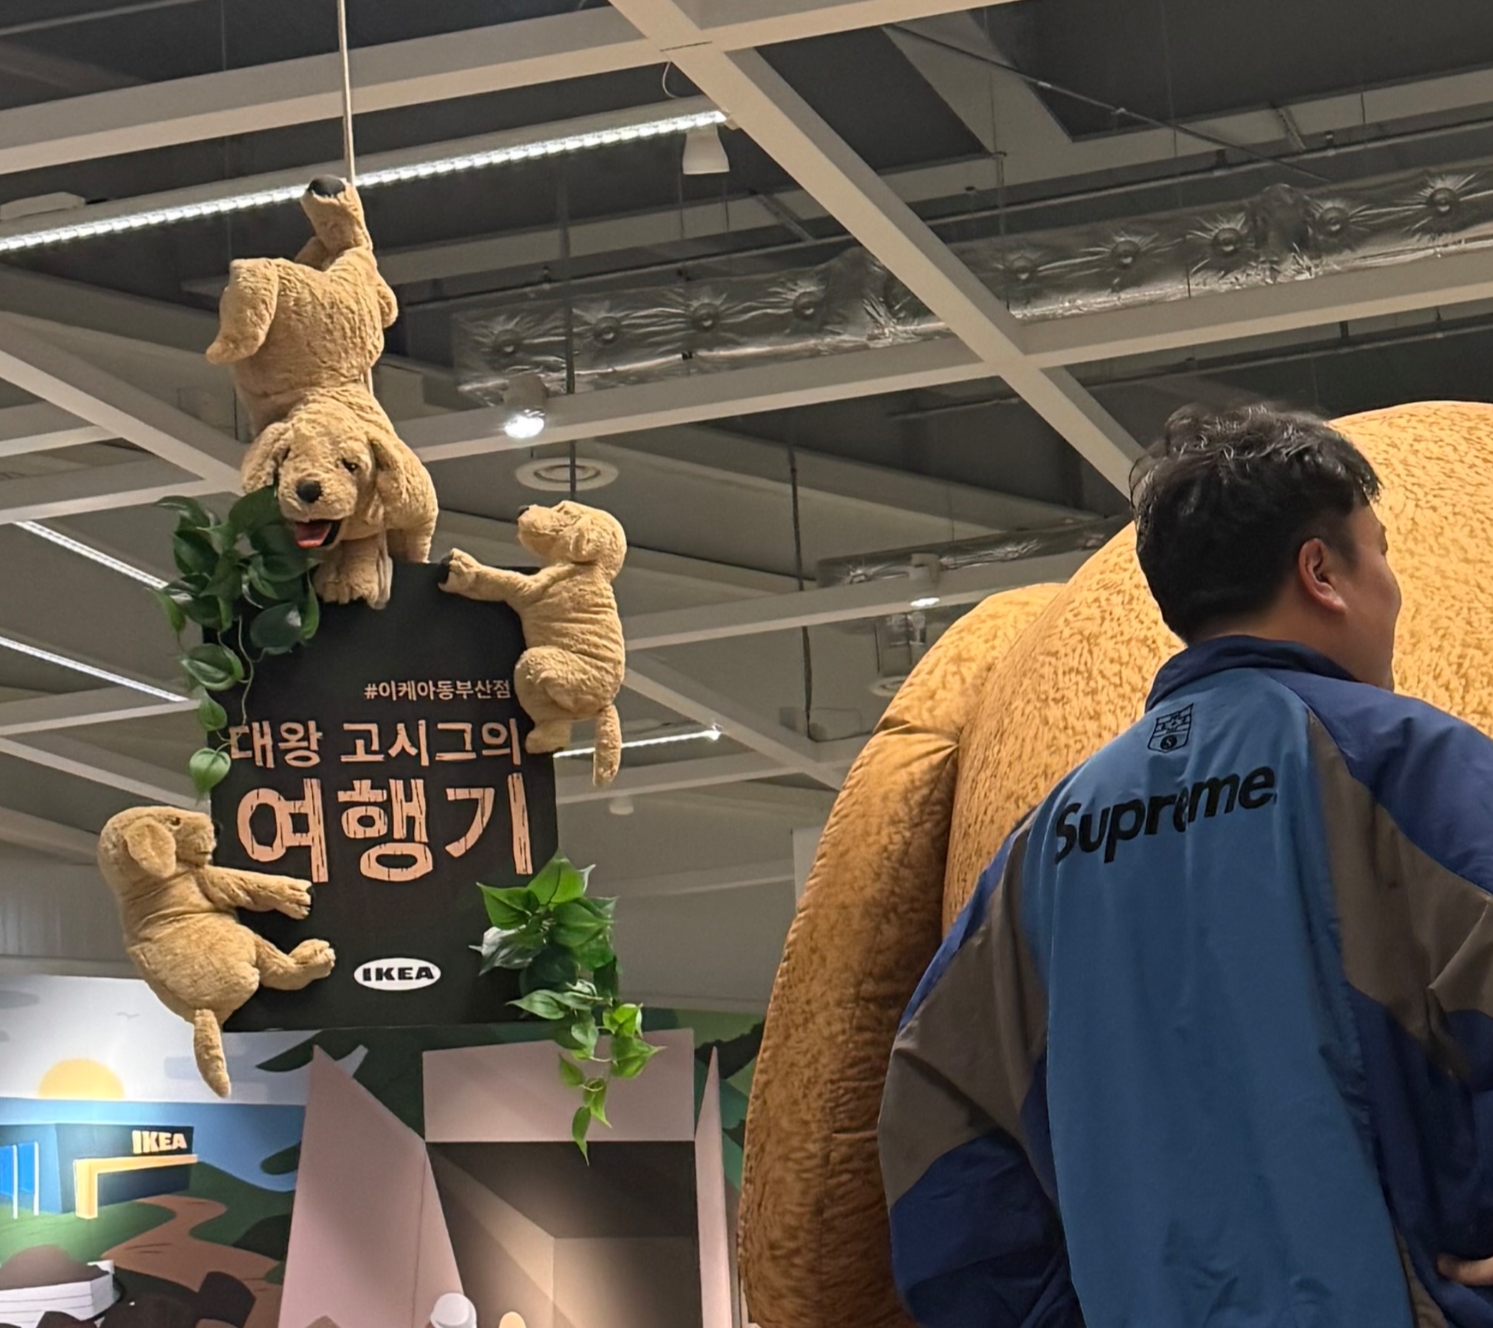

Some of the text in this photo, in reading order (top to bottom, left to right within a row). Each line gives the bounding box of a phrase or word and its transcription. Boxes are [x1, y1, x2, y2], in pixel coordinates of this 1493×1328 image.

[364, 679, 511, 701] #이케아동부산점
[229, 718, 521, 768] 대왕 고시그의
[237, 773, 532, 882] 여행기
[1054, 766, 1276, 864] Supreme
[363, 966, 434, 981] IKEA
[132, 1130, 187, 1154] IKEA
